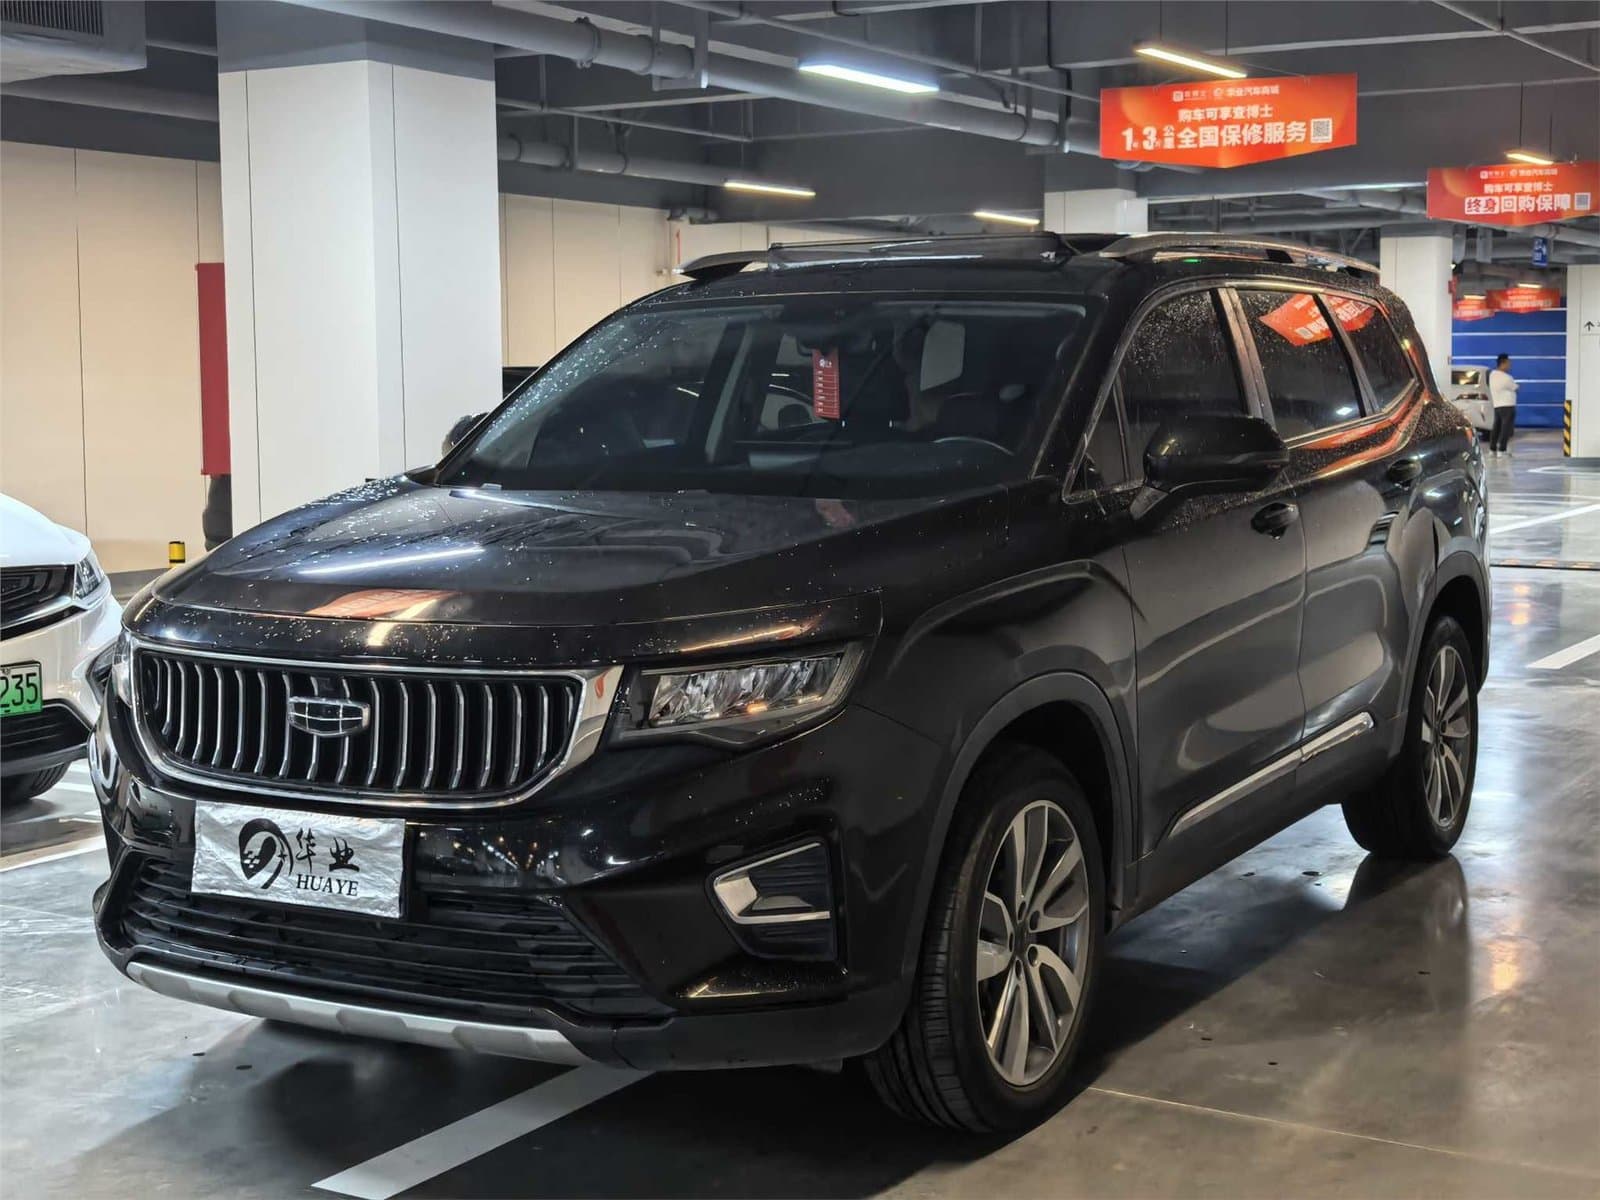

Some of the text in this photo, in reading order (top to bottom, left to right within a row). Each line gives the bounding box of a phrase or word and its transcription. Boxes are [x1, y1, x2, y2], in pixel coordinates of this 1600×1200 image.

[1466, 194, 1571, 213] 终身回购保障
[296, 874, 359, 896] HUAYE
